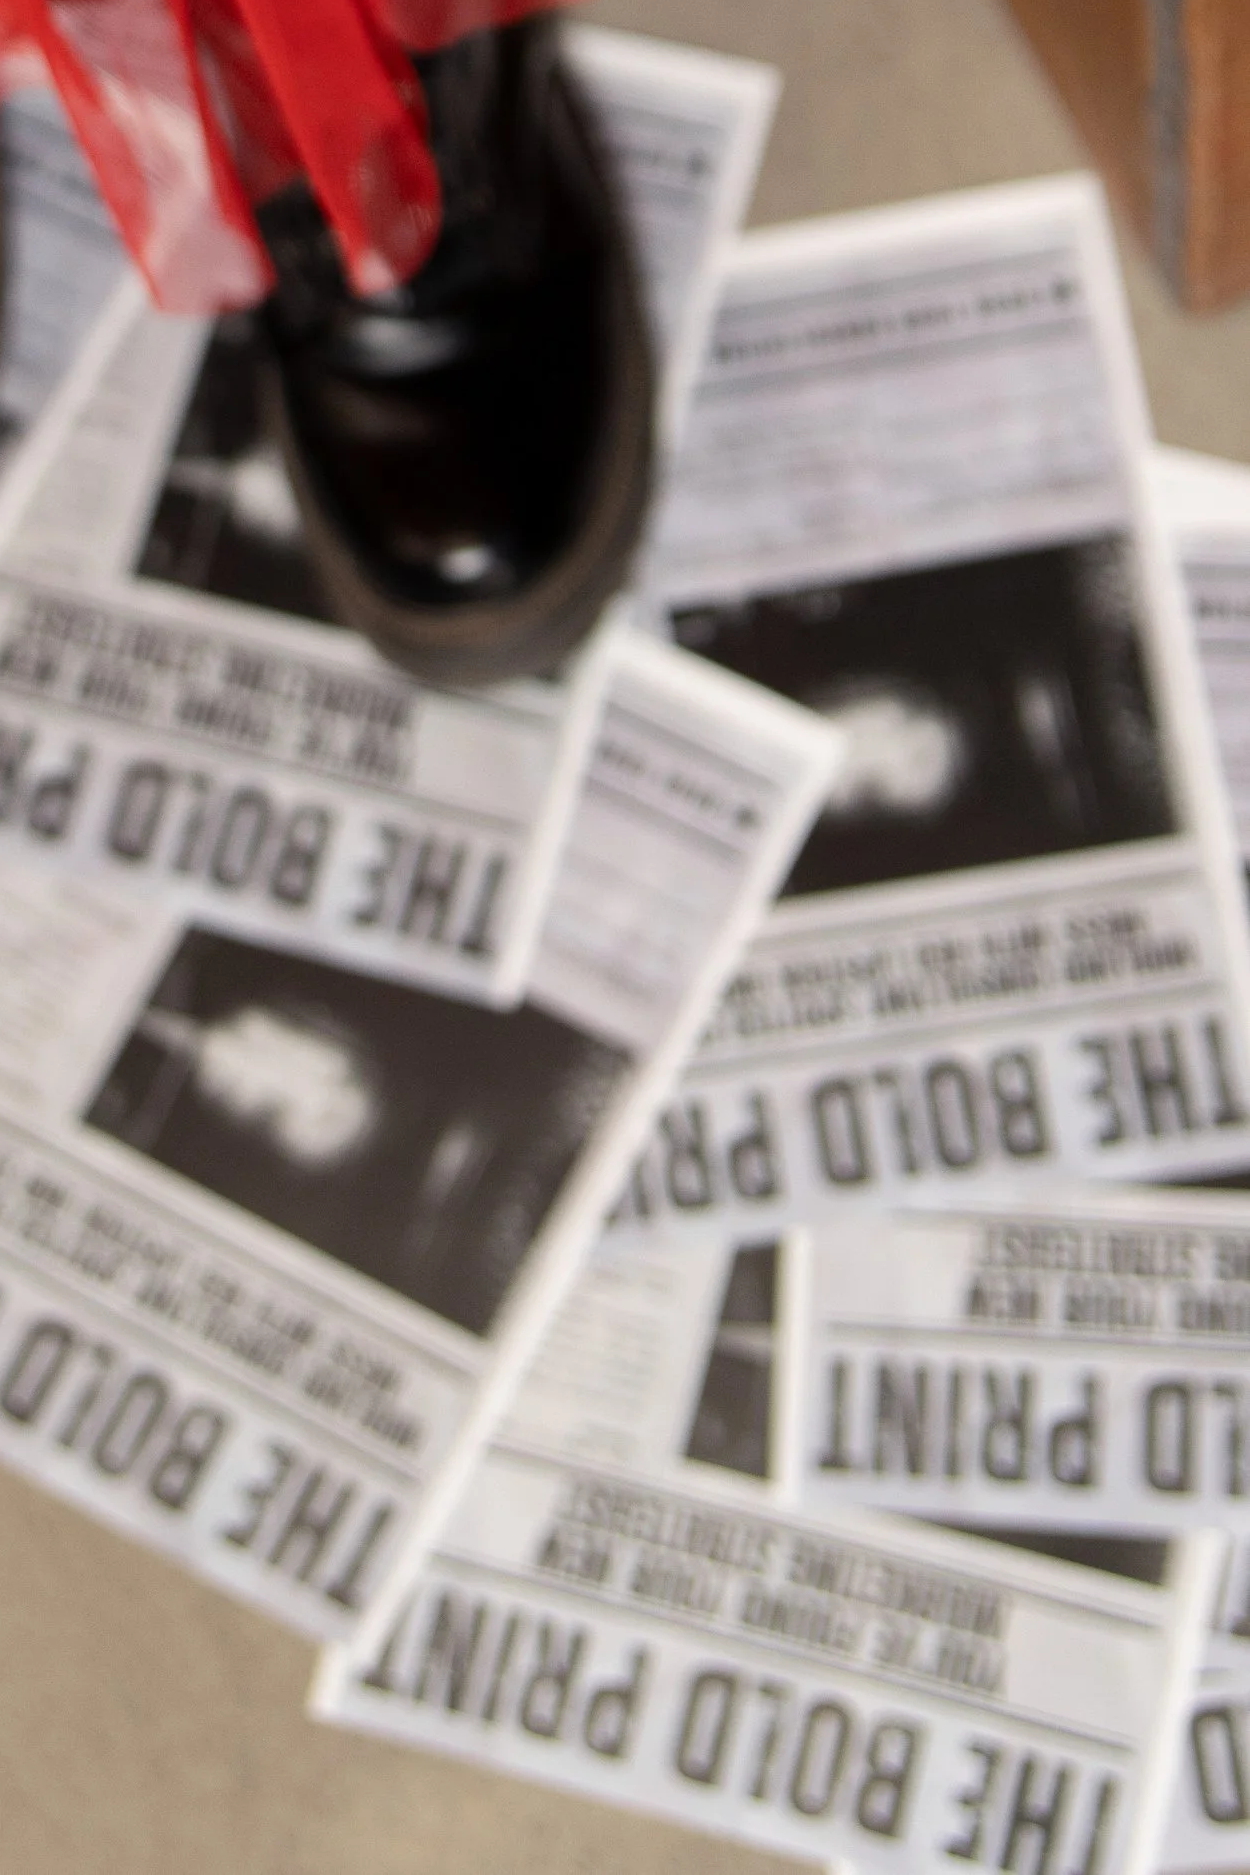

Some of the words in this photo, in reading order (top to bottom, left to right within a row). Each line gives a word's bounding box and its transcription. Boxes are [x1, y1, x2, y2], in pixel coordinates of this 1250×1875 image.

[99, 757, 334, 912] BOLD
[349, 828, 509, 960] THE
[806, 1050, 1049, 1189] BOLD
[1080, 1018, 1250, 1146] THE
[817, 1363, 1095, 1485] PRINT
[1141, 1382, 1250, 1495] LD
[218, 1442, 399, 1611] THE
[668, 1664, 925, 1839] BOLD
